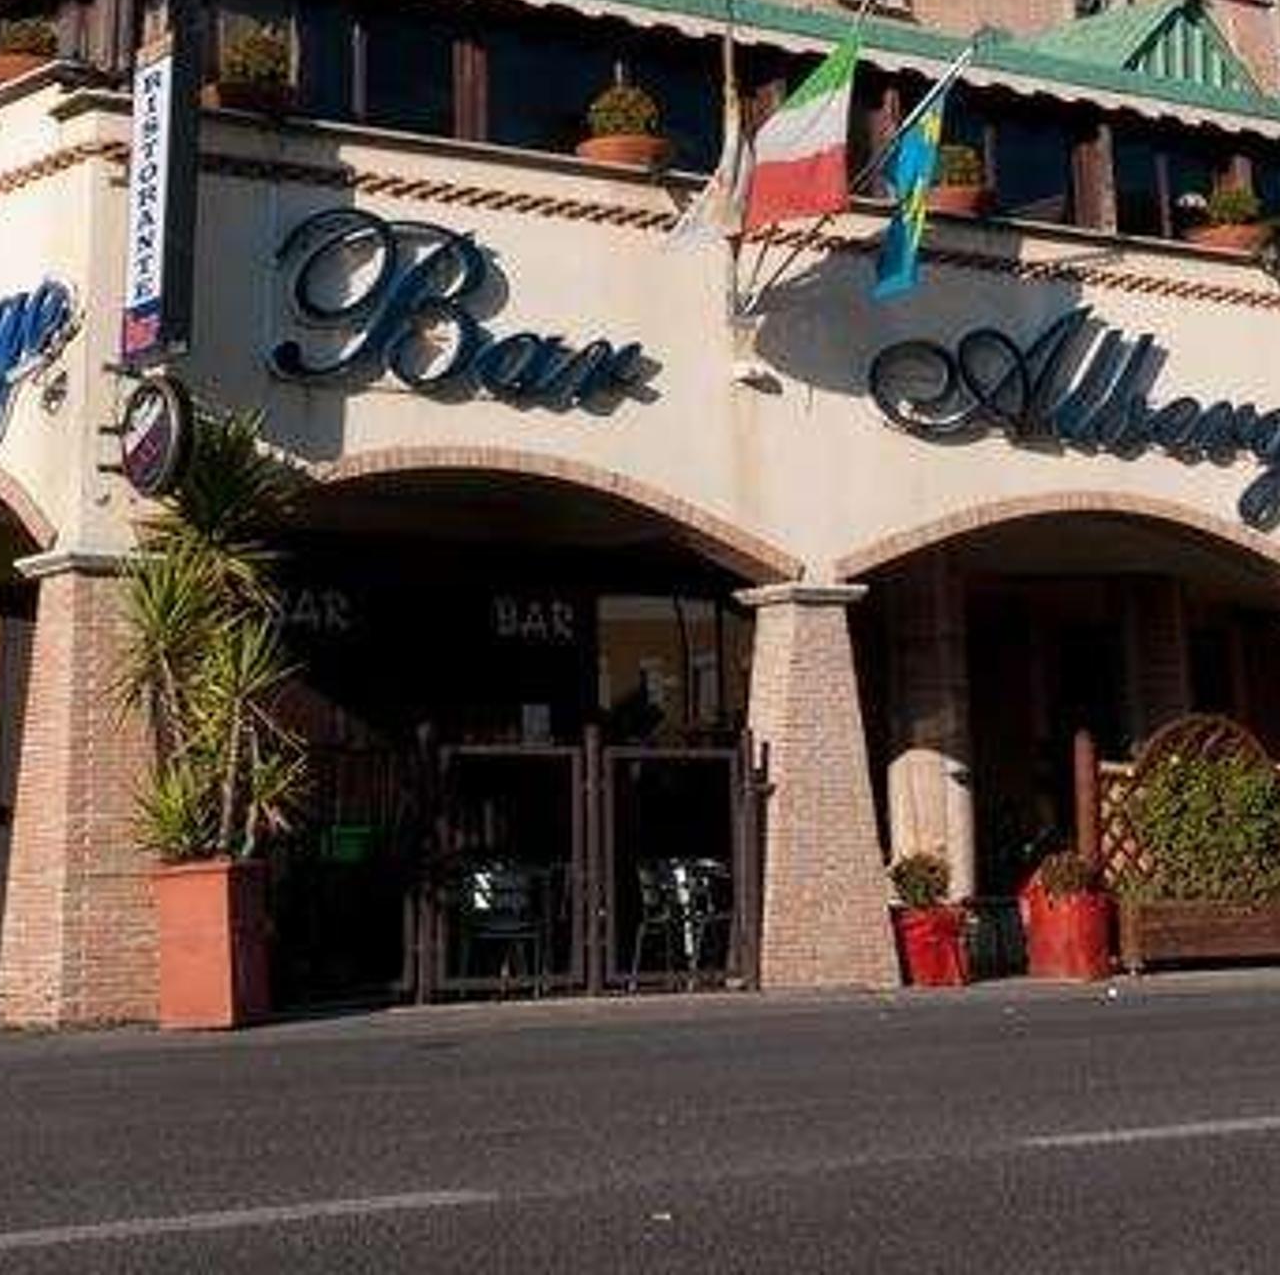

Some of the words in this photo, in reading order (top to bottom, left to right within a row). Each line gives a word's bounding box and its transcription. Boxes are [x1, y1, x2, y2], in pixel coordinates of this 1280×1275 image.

[133, 70, 163, 298] RISTORANTE
[274, 208, 646, 390] Bar
[490, 591, 575, 640] BAR
